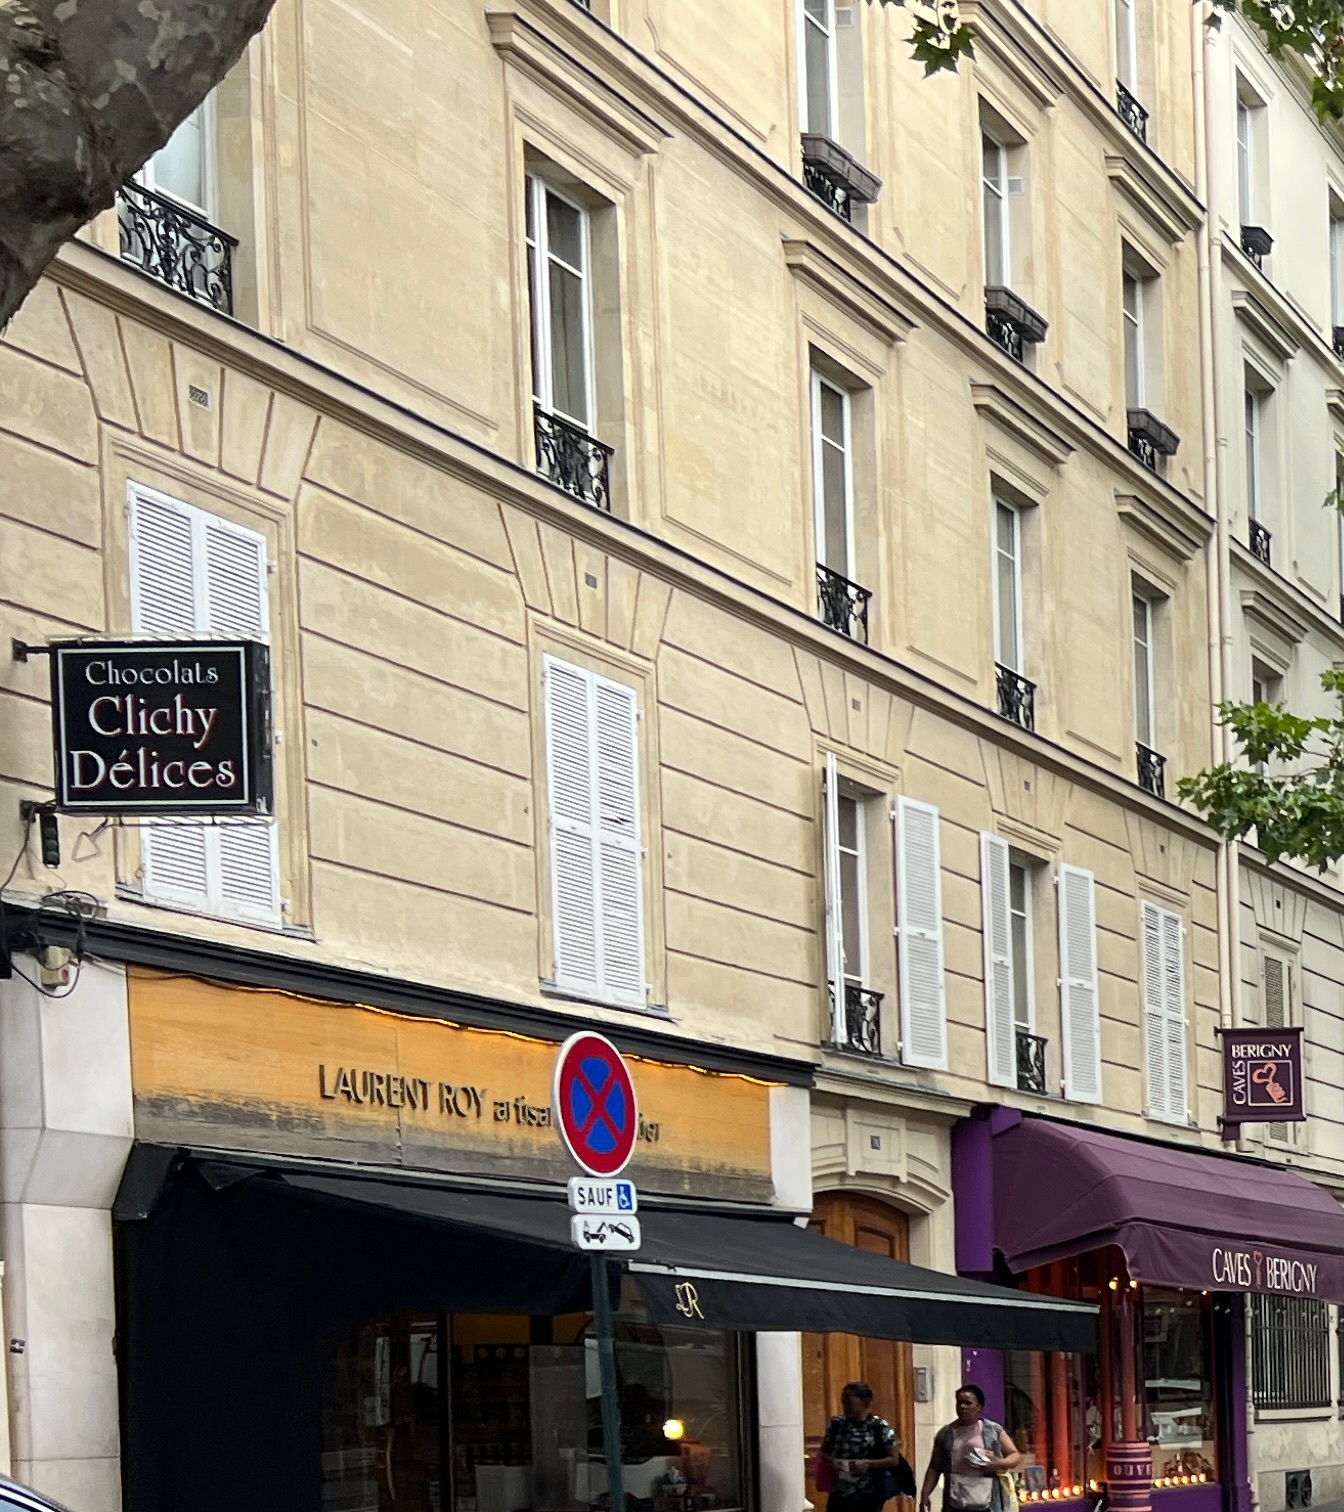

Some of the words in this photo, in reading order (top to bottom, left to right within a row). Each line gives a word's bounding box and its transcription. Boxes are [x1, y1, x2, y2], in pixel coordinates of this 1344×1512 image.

[85, 659, 219, 685] Chocolats
[88, 693, 219, 749] Clichy
[69, 746, 237, 790] Délices
[1231, 1043, 1292, 1058] BERIGNY
[319, 1064, 433, 1112] LAURENT
[439, 1080, 489, 1119] ROY
[493, 1095, 553, 1127] artisa
[1232, 1060, 1246, 1105] CAVES
[577, 1186, 613, 1207] SAUF
[1213, 1248, 1251, 1287] CAVES
[1266, 1256, 1318, 1294] BERIGNY
